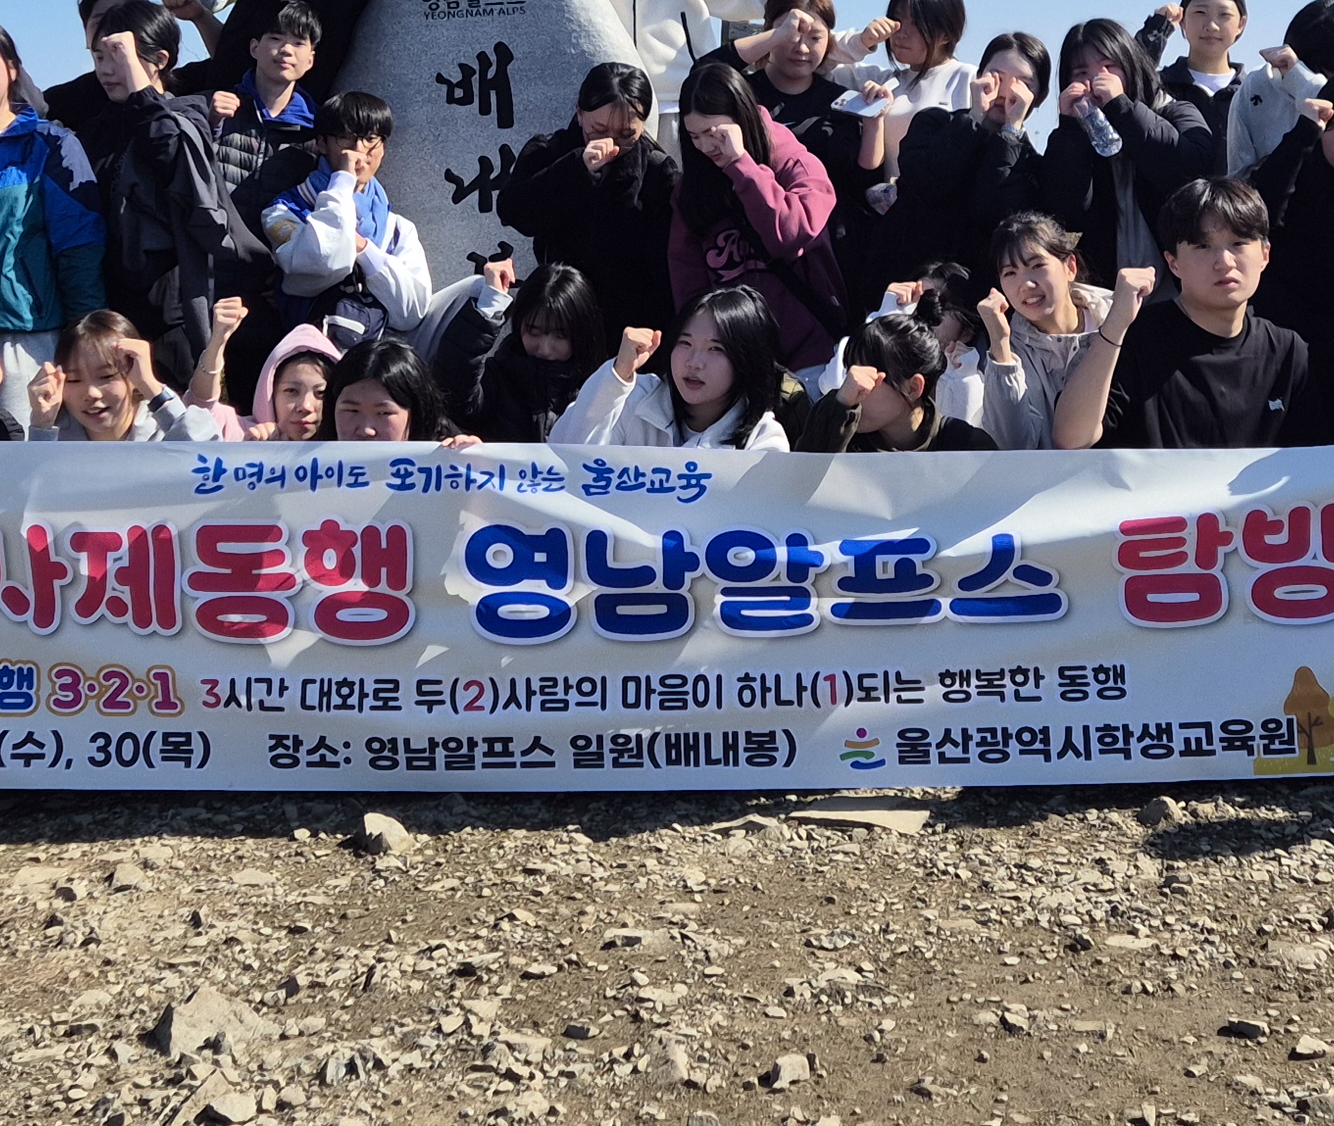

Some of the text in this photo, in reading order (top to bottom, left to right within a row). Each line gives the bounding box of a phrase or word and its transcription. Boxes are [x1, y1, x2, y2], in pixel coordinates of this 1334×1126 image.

[424, 6, 526, 20] YEONGNAM ALPS
[192, 454, 712, 503] 한 명의 아이도 포기하지 않는 울산교육
[464, 524, 1063, 639] 영남알프스
[200, 677, 289, 712] 3시간
[300, 677, 403, 713] 대화로
[414, 676, 608, 715] 두(2)사람의
[621, 674, 723, 711] 마음이
[736, 670, 926, 709] 하나(1)되는
[938, 665, 1045, 704] 행복한
[1057, 664, 1128, 702] 동행
[87, 730, 212, 769] 30(목)
[268, 728, 798, 770] 장소: 영남알프스 일원(배내봉)
[896, 717, 1298, 765] 울산광역시학생교육원
